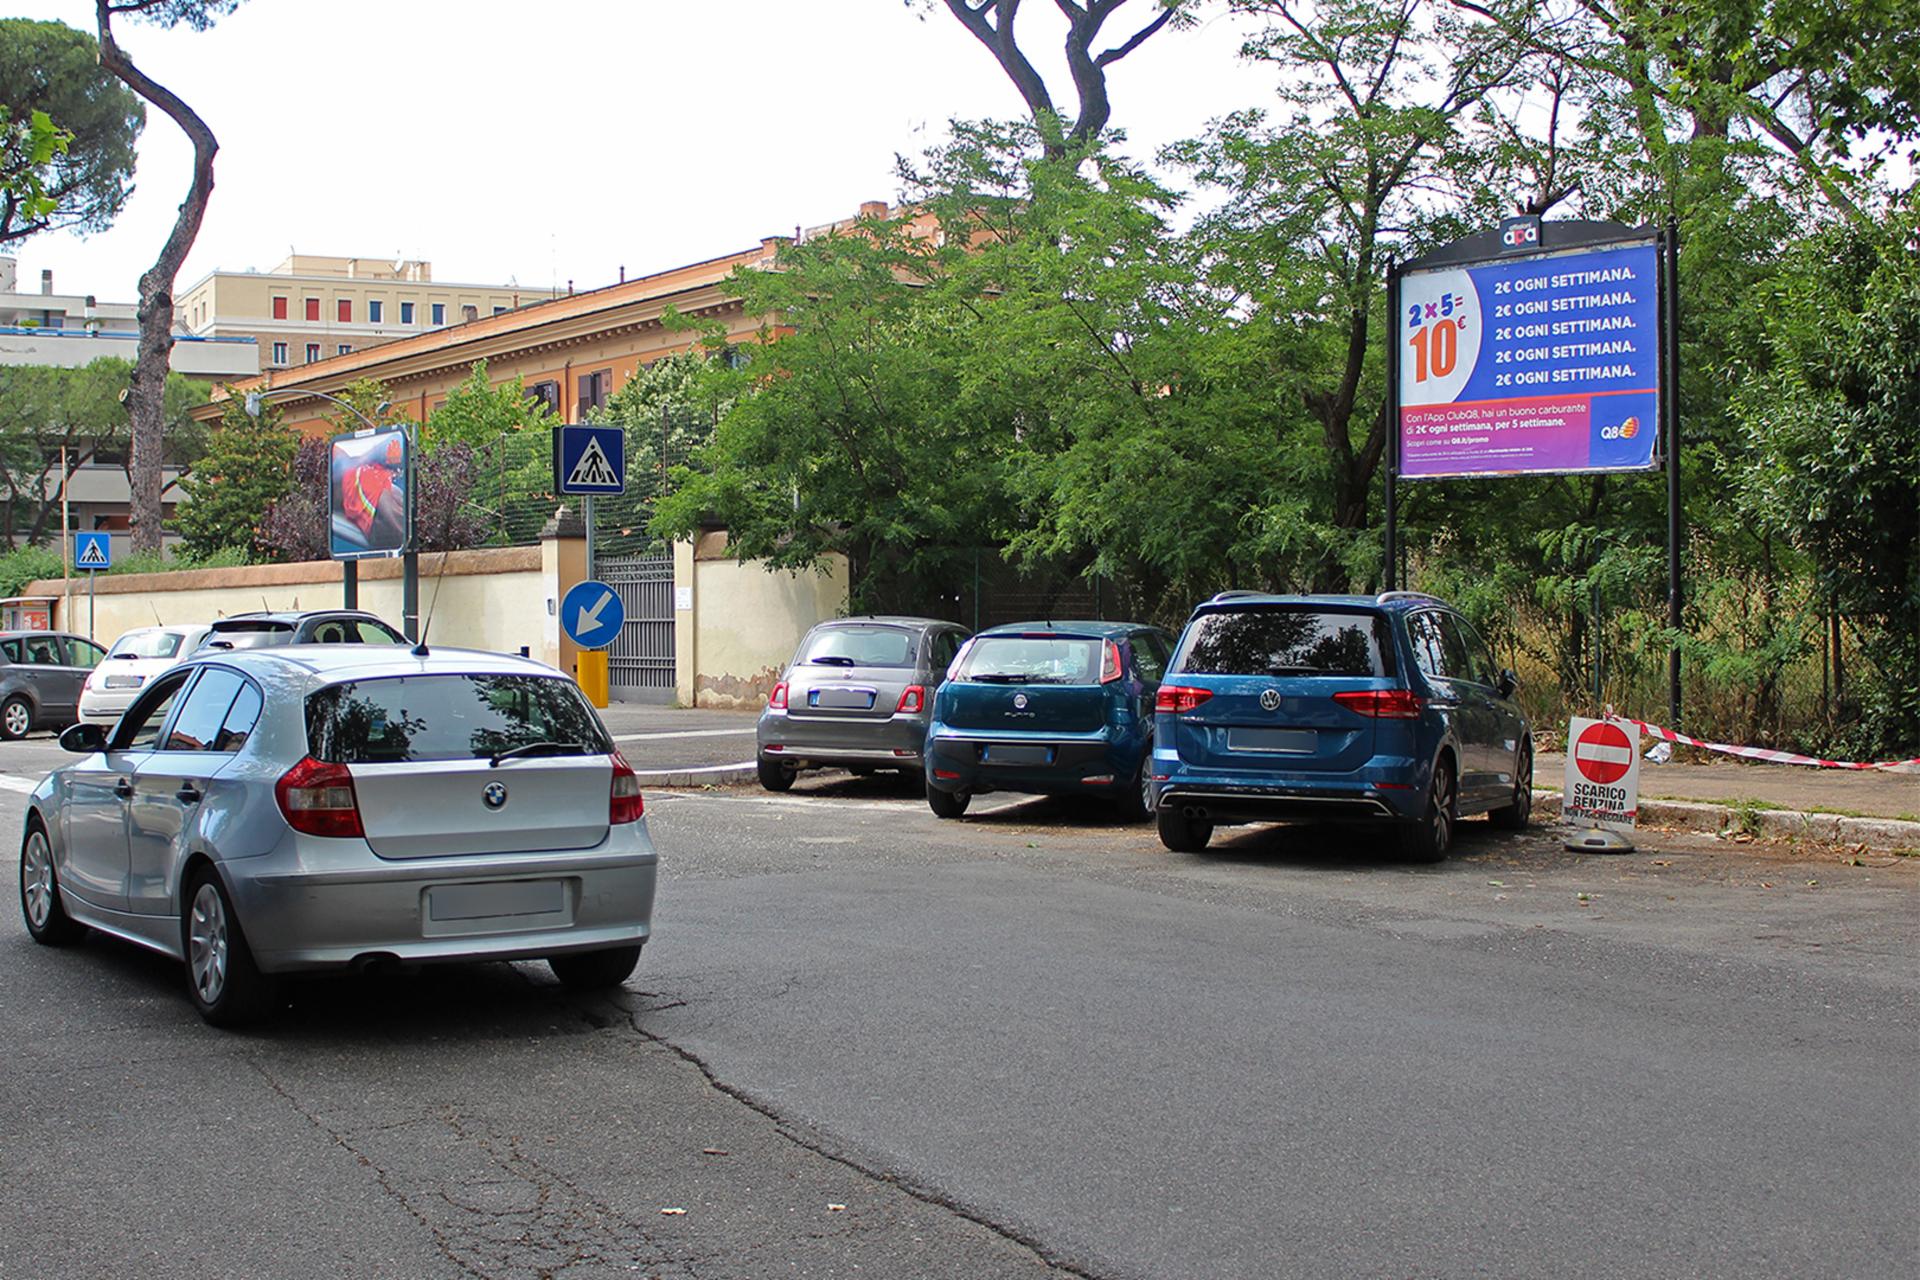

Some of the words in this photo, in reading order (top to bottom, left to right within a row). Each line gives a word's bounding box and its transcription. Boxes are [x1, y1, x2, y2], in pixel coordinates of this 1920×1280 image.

[1495, 281, 1511, 294] 2€
[1514, 277, 1548, 292] OGNI
[1551, 267, 1636, 288] SETTIMANA.
[1495, 304, 1512, 317] 2€
[1514, 300, 1548, 315] OGNI
[1551, 291, 1637, 311] SETTIMANA.
[1495, 327, 1512, 340] 2€
[1515, 324, 1549, 338] OGNI
[1552, 316, 1637, 335] SETTIMANA.
[1495, 350, 1512, 363] 2€
[1515, 347, 1549, 361] OGNI
[1552, 340, 1637, 359] SETTIMANA.
[1495, 373, 1512, 386] 2€
[1515, 371, 1549, 385] OGNI
[1552, 364, 1637, 383] SETTIMANA.
[1406, 414, 1422, 423] Con
[1482, 408, 1494, 418] hai
[1496, 409, 1507, 417] un
[1509, 406, 1536, 416] buono
[1538, 404, 1586, 415] carburante
[1429, 424, 1448, 434] ogni
[1449, 422, 1494, 432] settimana,
[1495, 420, 1510, 431] per
[1512, 419, 1518, 429] 5
[1519, 417, 1566, 429] settimane.
[1600, 426, 1619, 439] Q8
[1574, 783, 1626, 801] SCARICO
[1573, 795, 1625, 811] BENZINA
